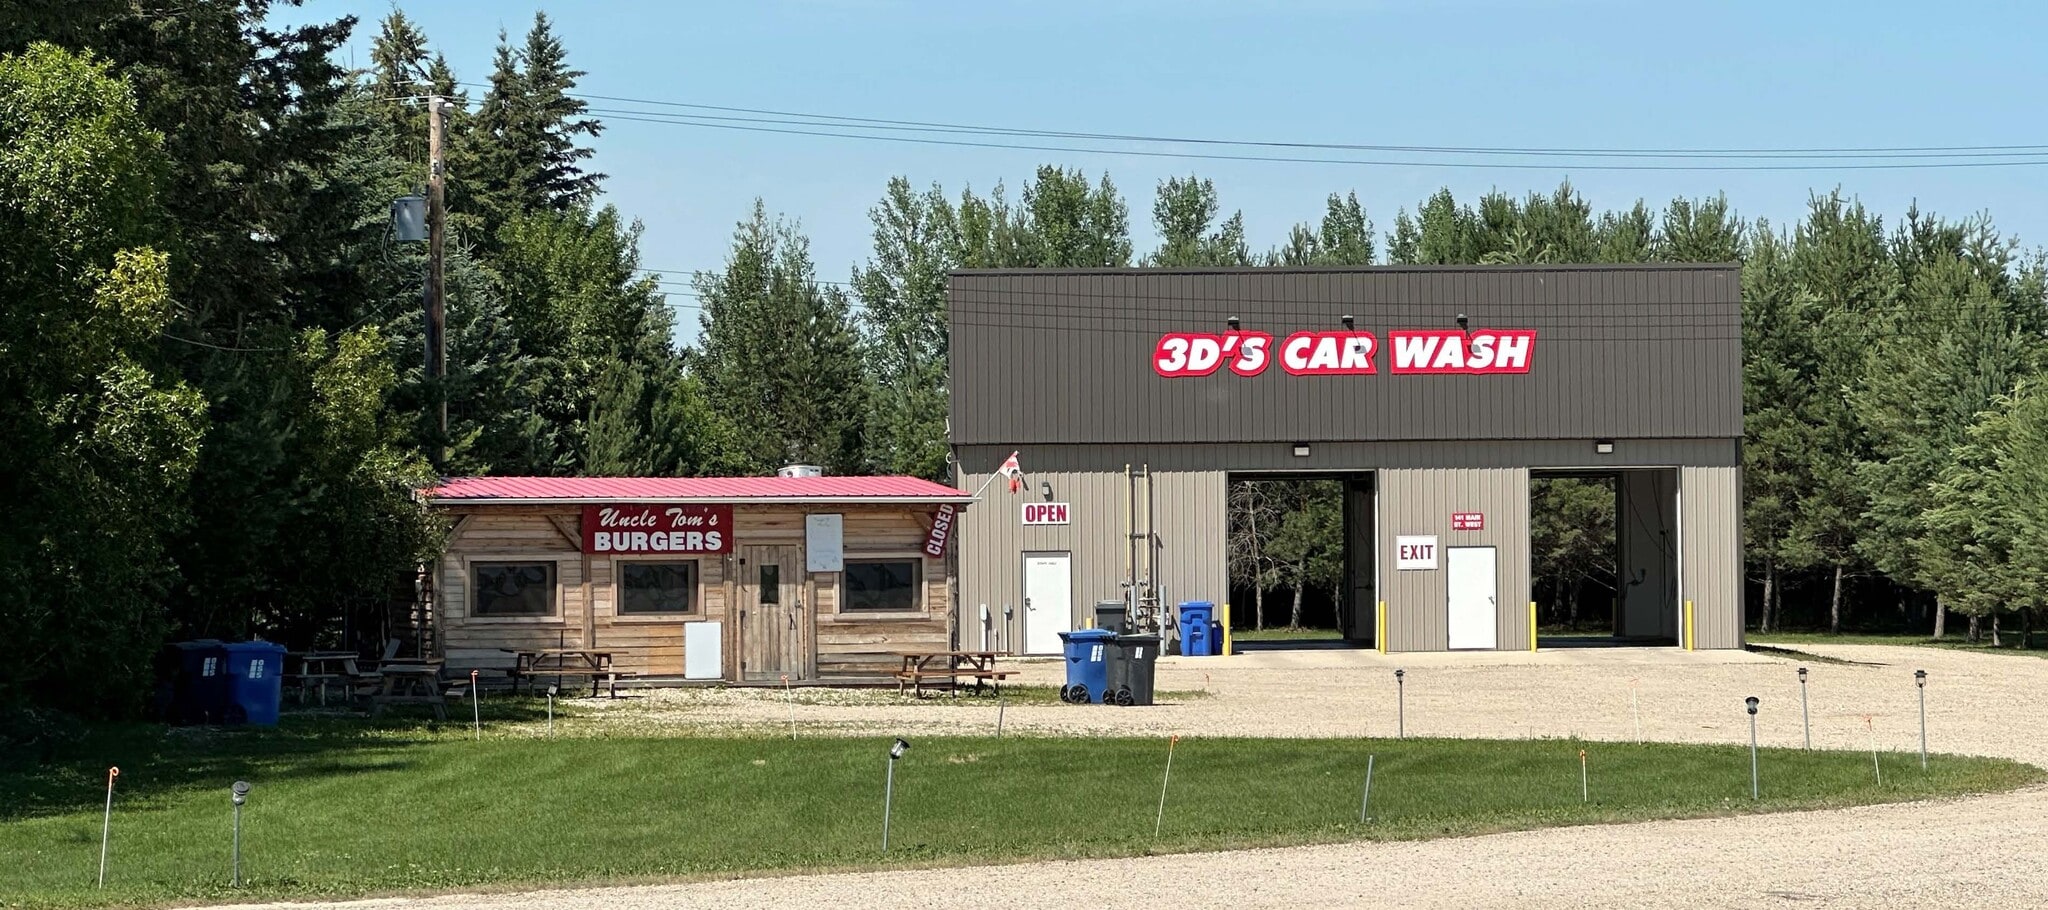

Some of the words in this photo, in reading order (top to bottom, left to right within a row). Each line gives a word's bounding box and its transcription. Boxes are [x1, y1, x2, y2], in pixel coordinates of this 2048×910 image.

[1157, 336, 1267, 371] 3D'S
[1283, 336, 1373, 370] CAR
[1394, 335, 1532, 369] WASH
[598, 507, 657, 528] Uncle
[665, 507, 719, 529] Tom's
[1025, 504, 1067, 522] OPEN
[926, 503, 954, 555] CLOSED
[594, 531, 722, 551] BURGERS
[1400, 544, 1434, 560] EXIT
